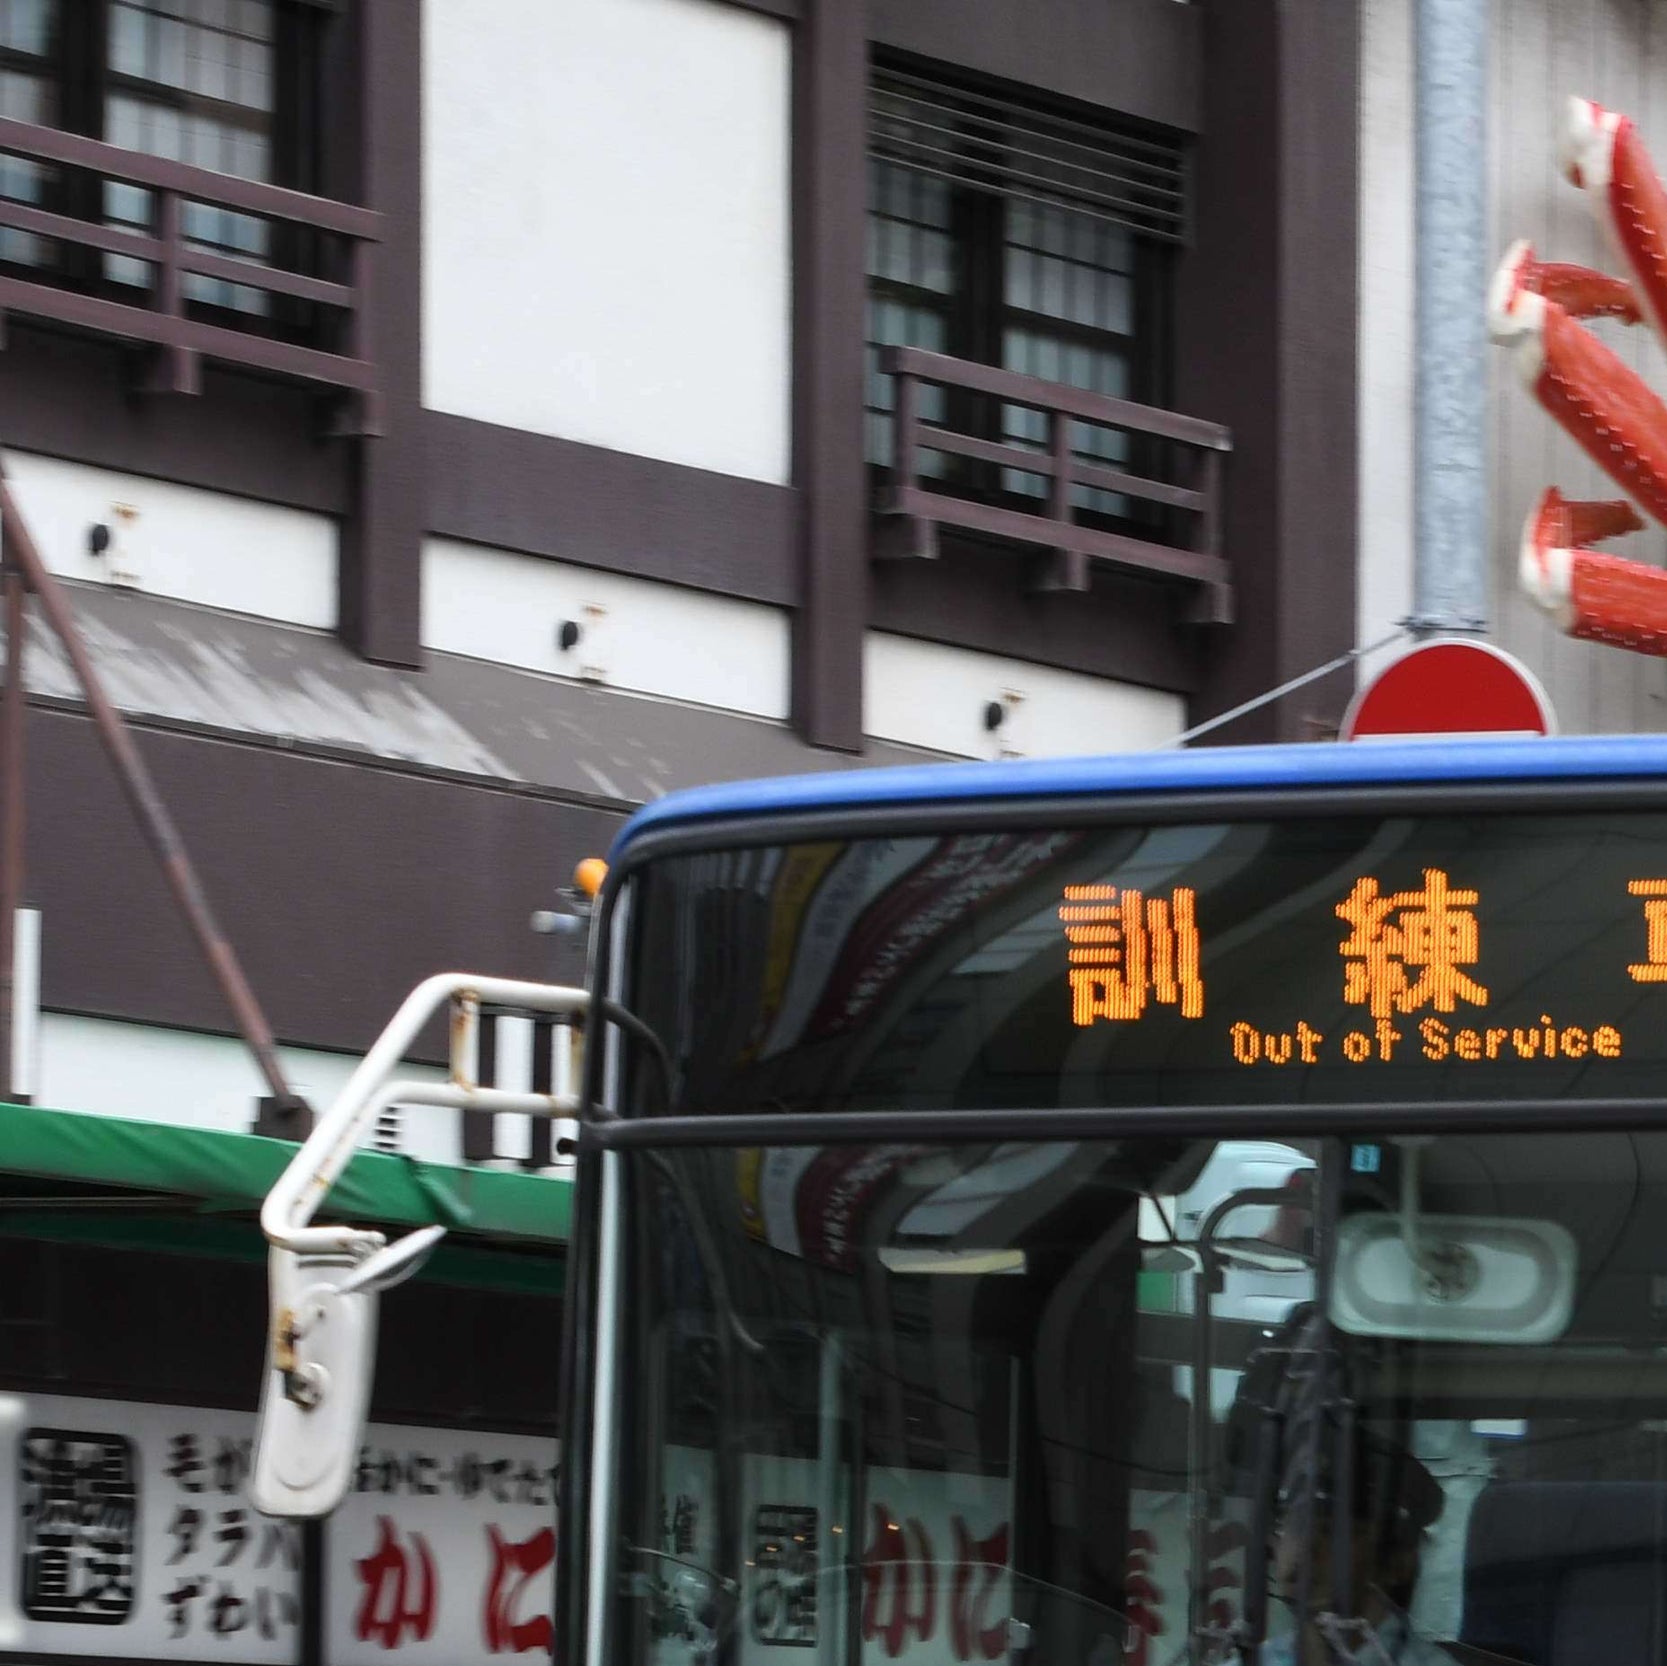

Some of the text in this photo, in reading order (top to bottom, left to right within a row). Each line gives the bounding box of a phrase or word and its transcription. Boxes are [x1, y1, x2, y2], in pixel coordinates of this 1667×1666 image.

[1230, 1015, 1622, 1065] Out of Service
[355, 1514, 554, 1656] かに
